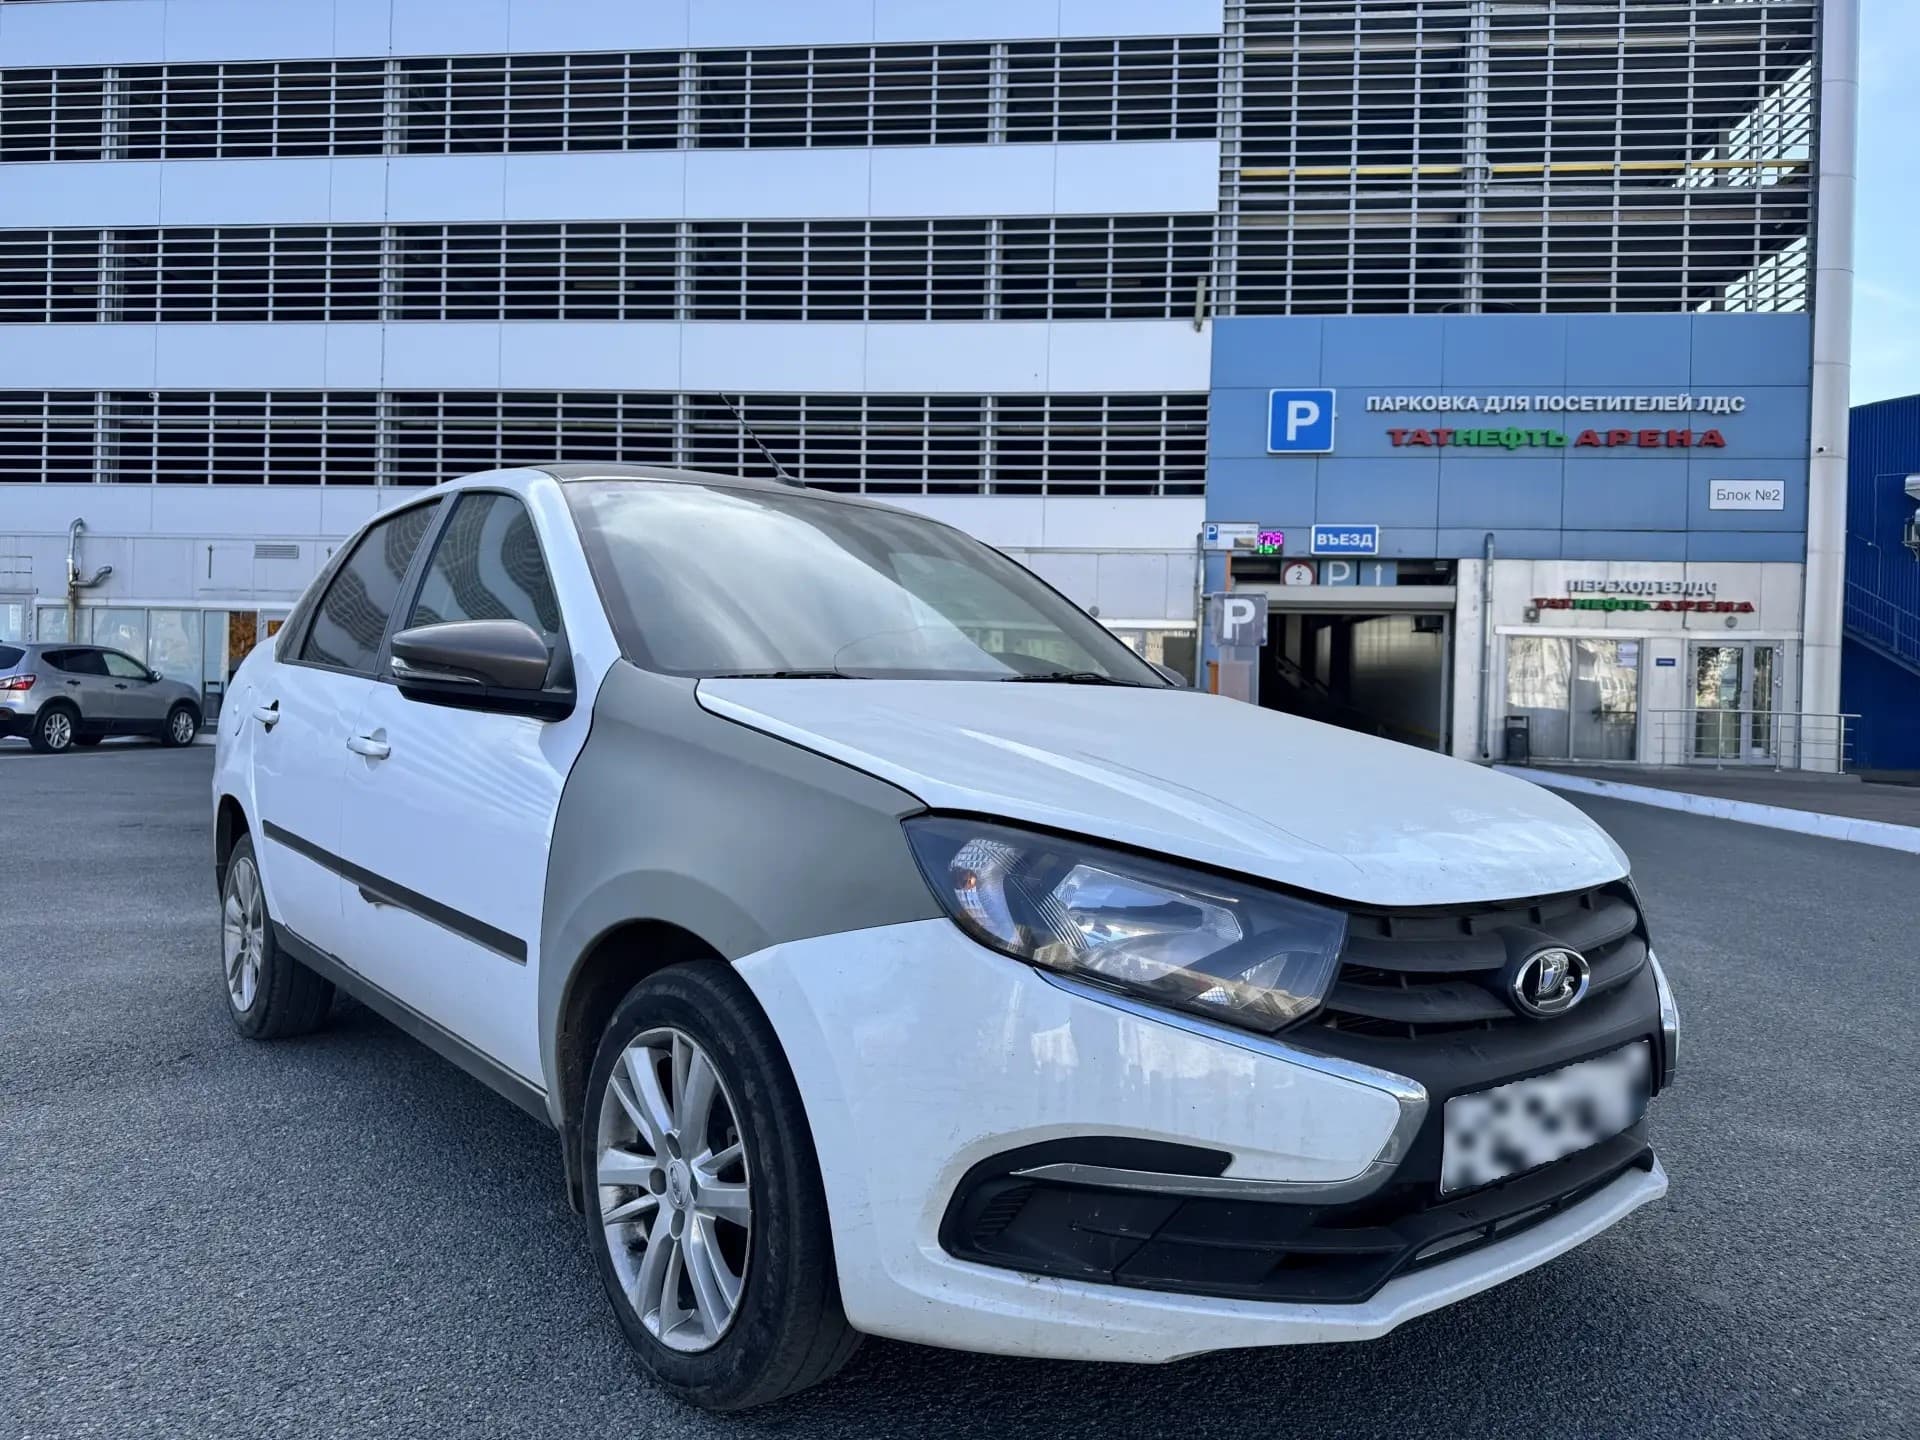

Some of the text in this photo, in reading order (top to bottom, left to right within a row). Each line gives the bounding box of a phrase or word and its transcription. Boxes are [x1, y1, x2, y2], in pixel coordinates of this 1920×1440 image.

[1366, 394, 1746, 413] ПАРКОВКА ДЛЯ ПОСЕТИТЕЛЕЙ ЛДС
[1287, 400, 1320, 441] P
[1387, 427, 1727, 450] ТАТНЕФТЬ АРЕНА
[1717, 488, 1781, 501] Блок №2
[1317, 534, 1373, 548] ВЪЕЗД
[1295, 571, 1303, 580] 2
[1328, 561, 1350, 586] P
[1567, 580, 1655, 595] ПЕРЕХОД
[1679, 581, 1717, 596] ЛДС
[1657, 600, 1755, 612] АРЕНА
[1223, 599, 1256, 640] P
